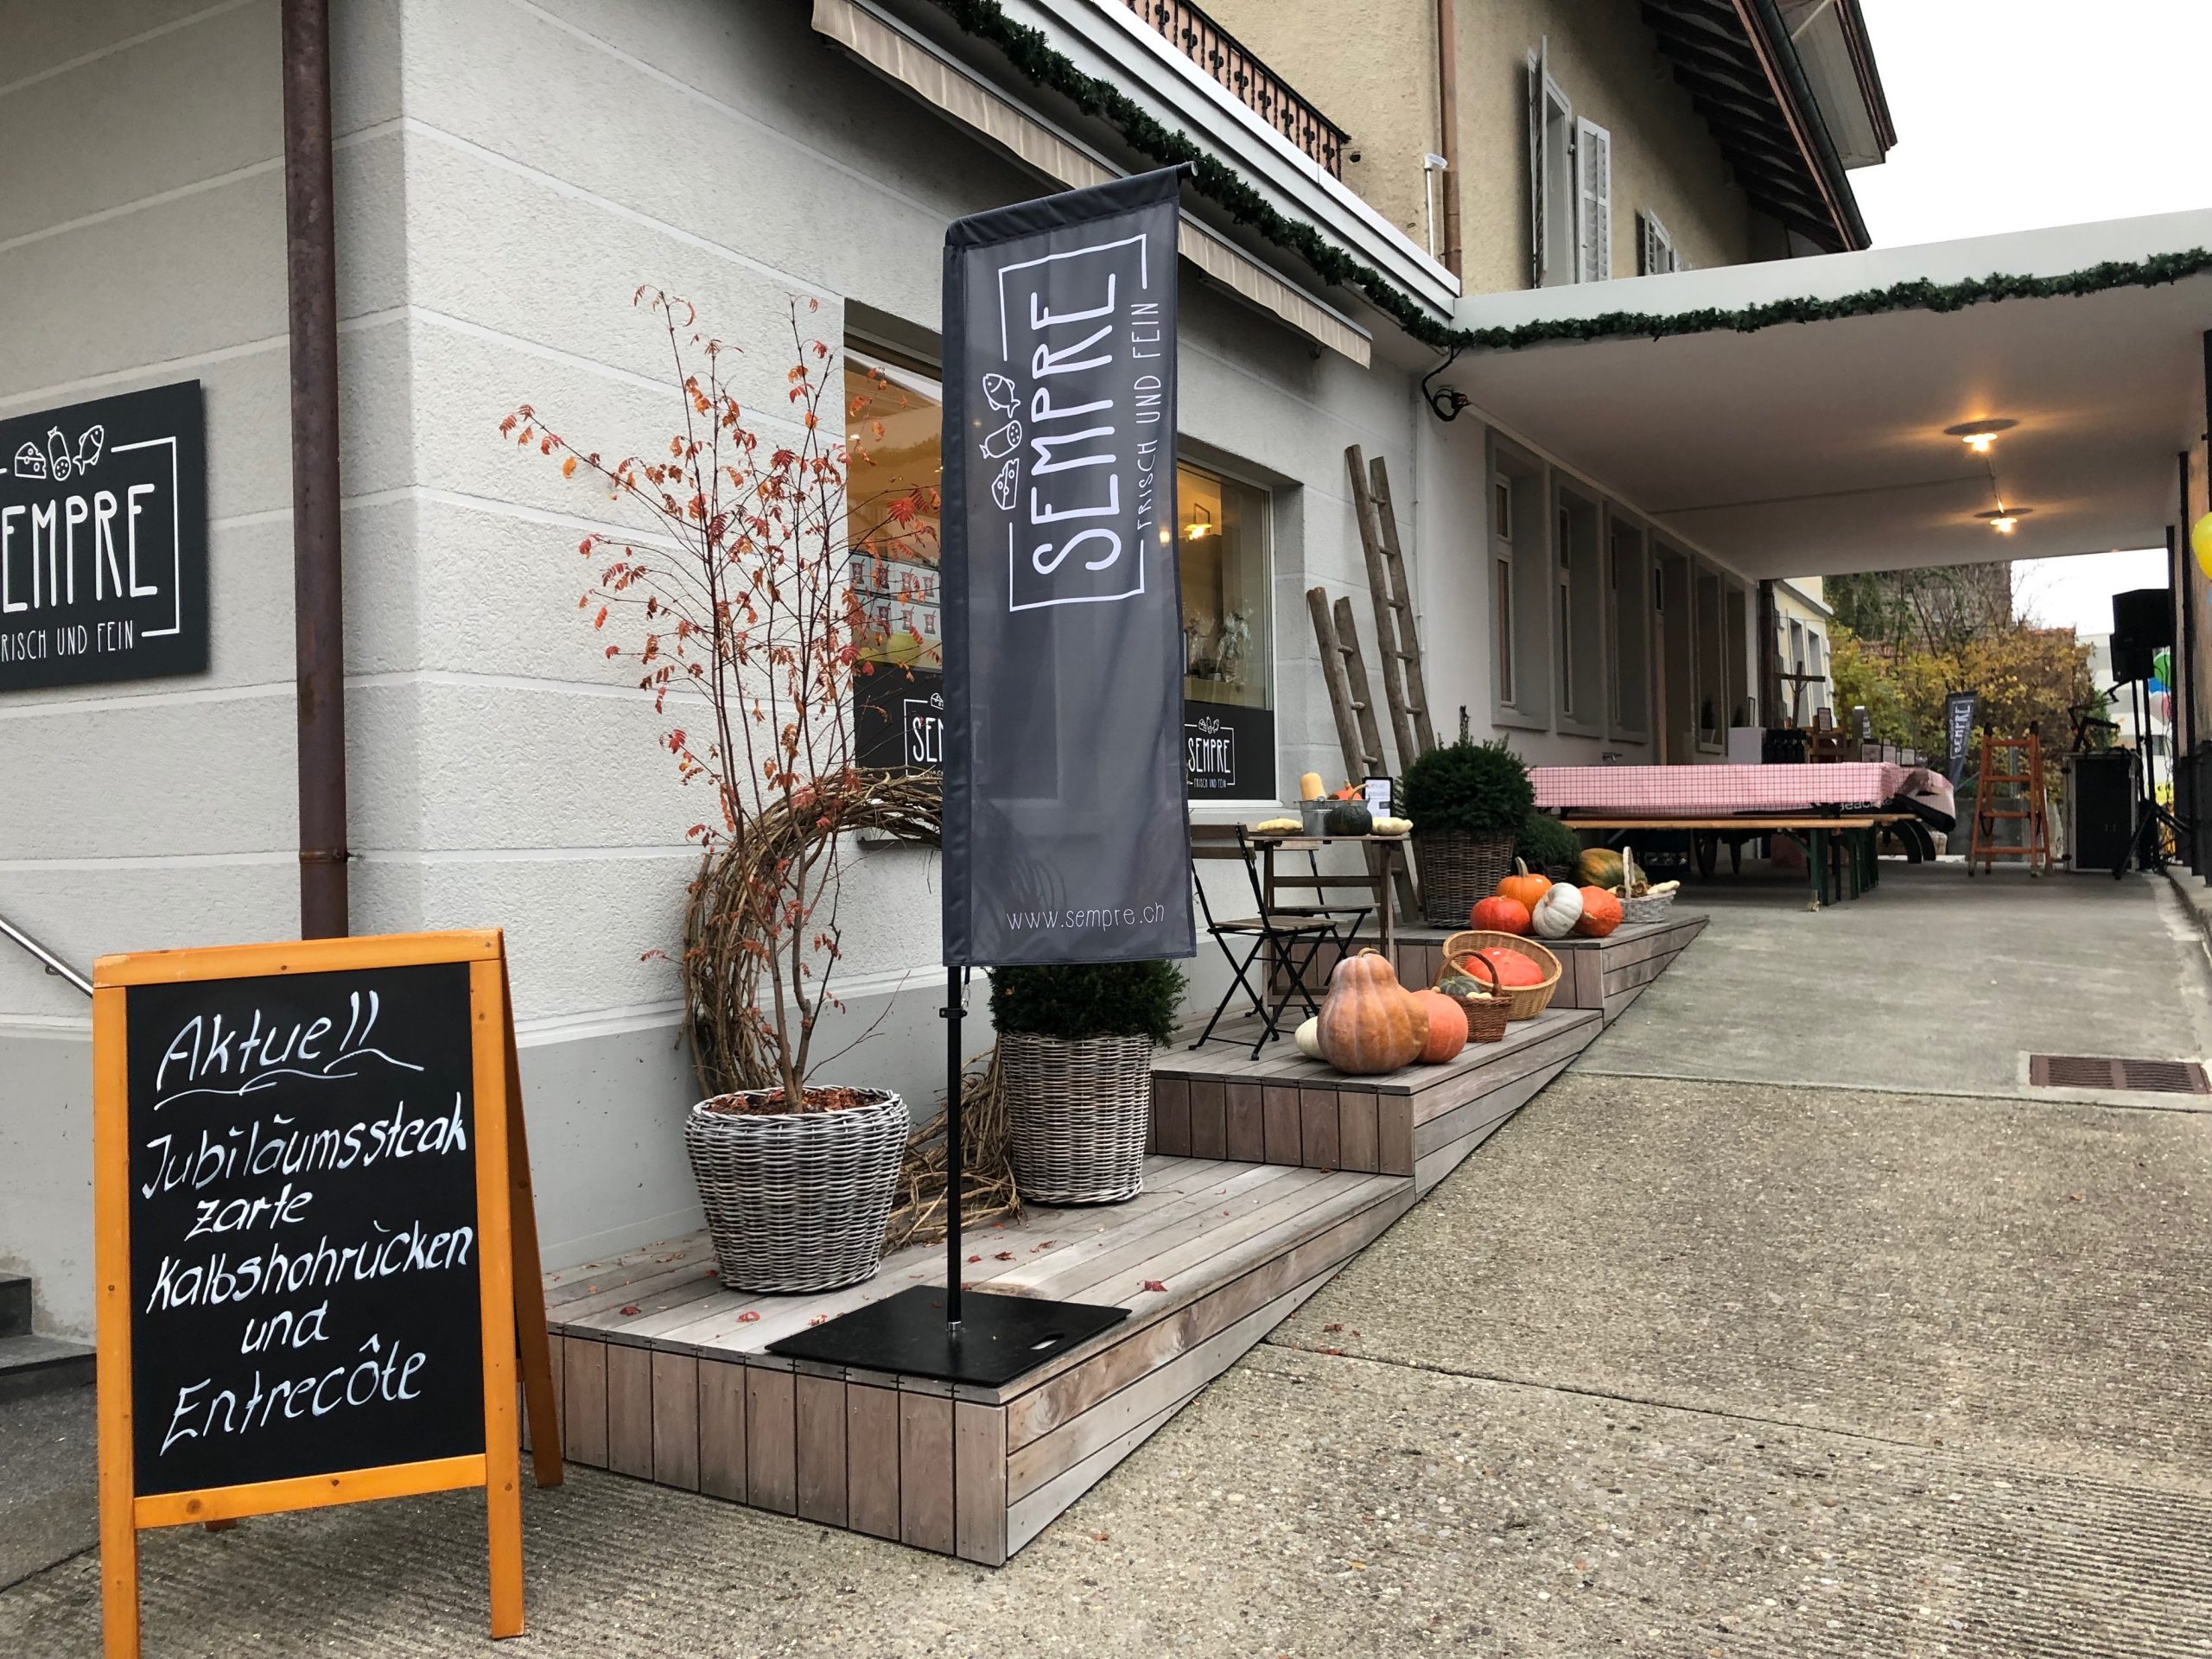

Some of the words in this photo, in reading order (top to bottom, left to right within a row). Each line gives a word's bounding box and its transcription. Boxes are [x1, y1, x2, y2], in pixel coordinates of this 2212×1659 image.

[1130, 302, 1161, 359] FEIN
[1030, 273, 1122, 575] SEMPRE
[1133, 374, 1162, 424] UND
[1136, 439, 1158, 531] FRISCH
[0, 483, 158, 613] EMPRE
[0, 629, 47, 664] RISCH
[57, 624, 87, 656] UND
[97, 620, 134, 653] FEIN
[1188, 737, 1231, 773] SEMPRE
[1006, 901, 1165, 931] www.sempre.ch
[240, 1299, 329, 1355] und
[160, 1338, 427, 1457] Entrecôte
